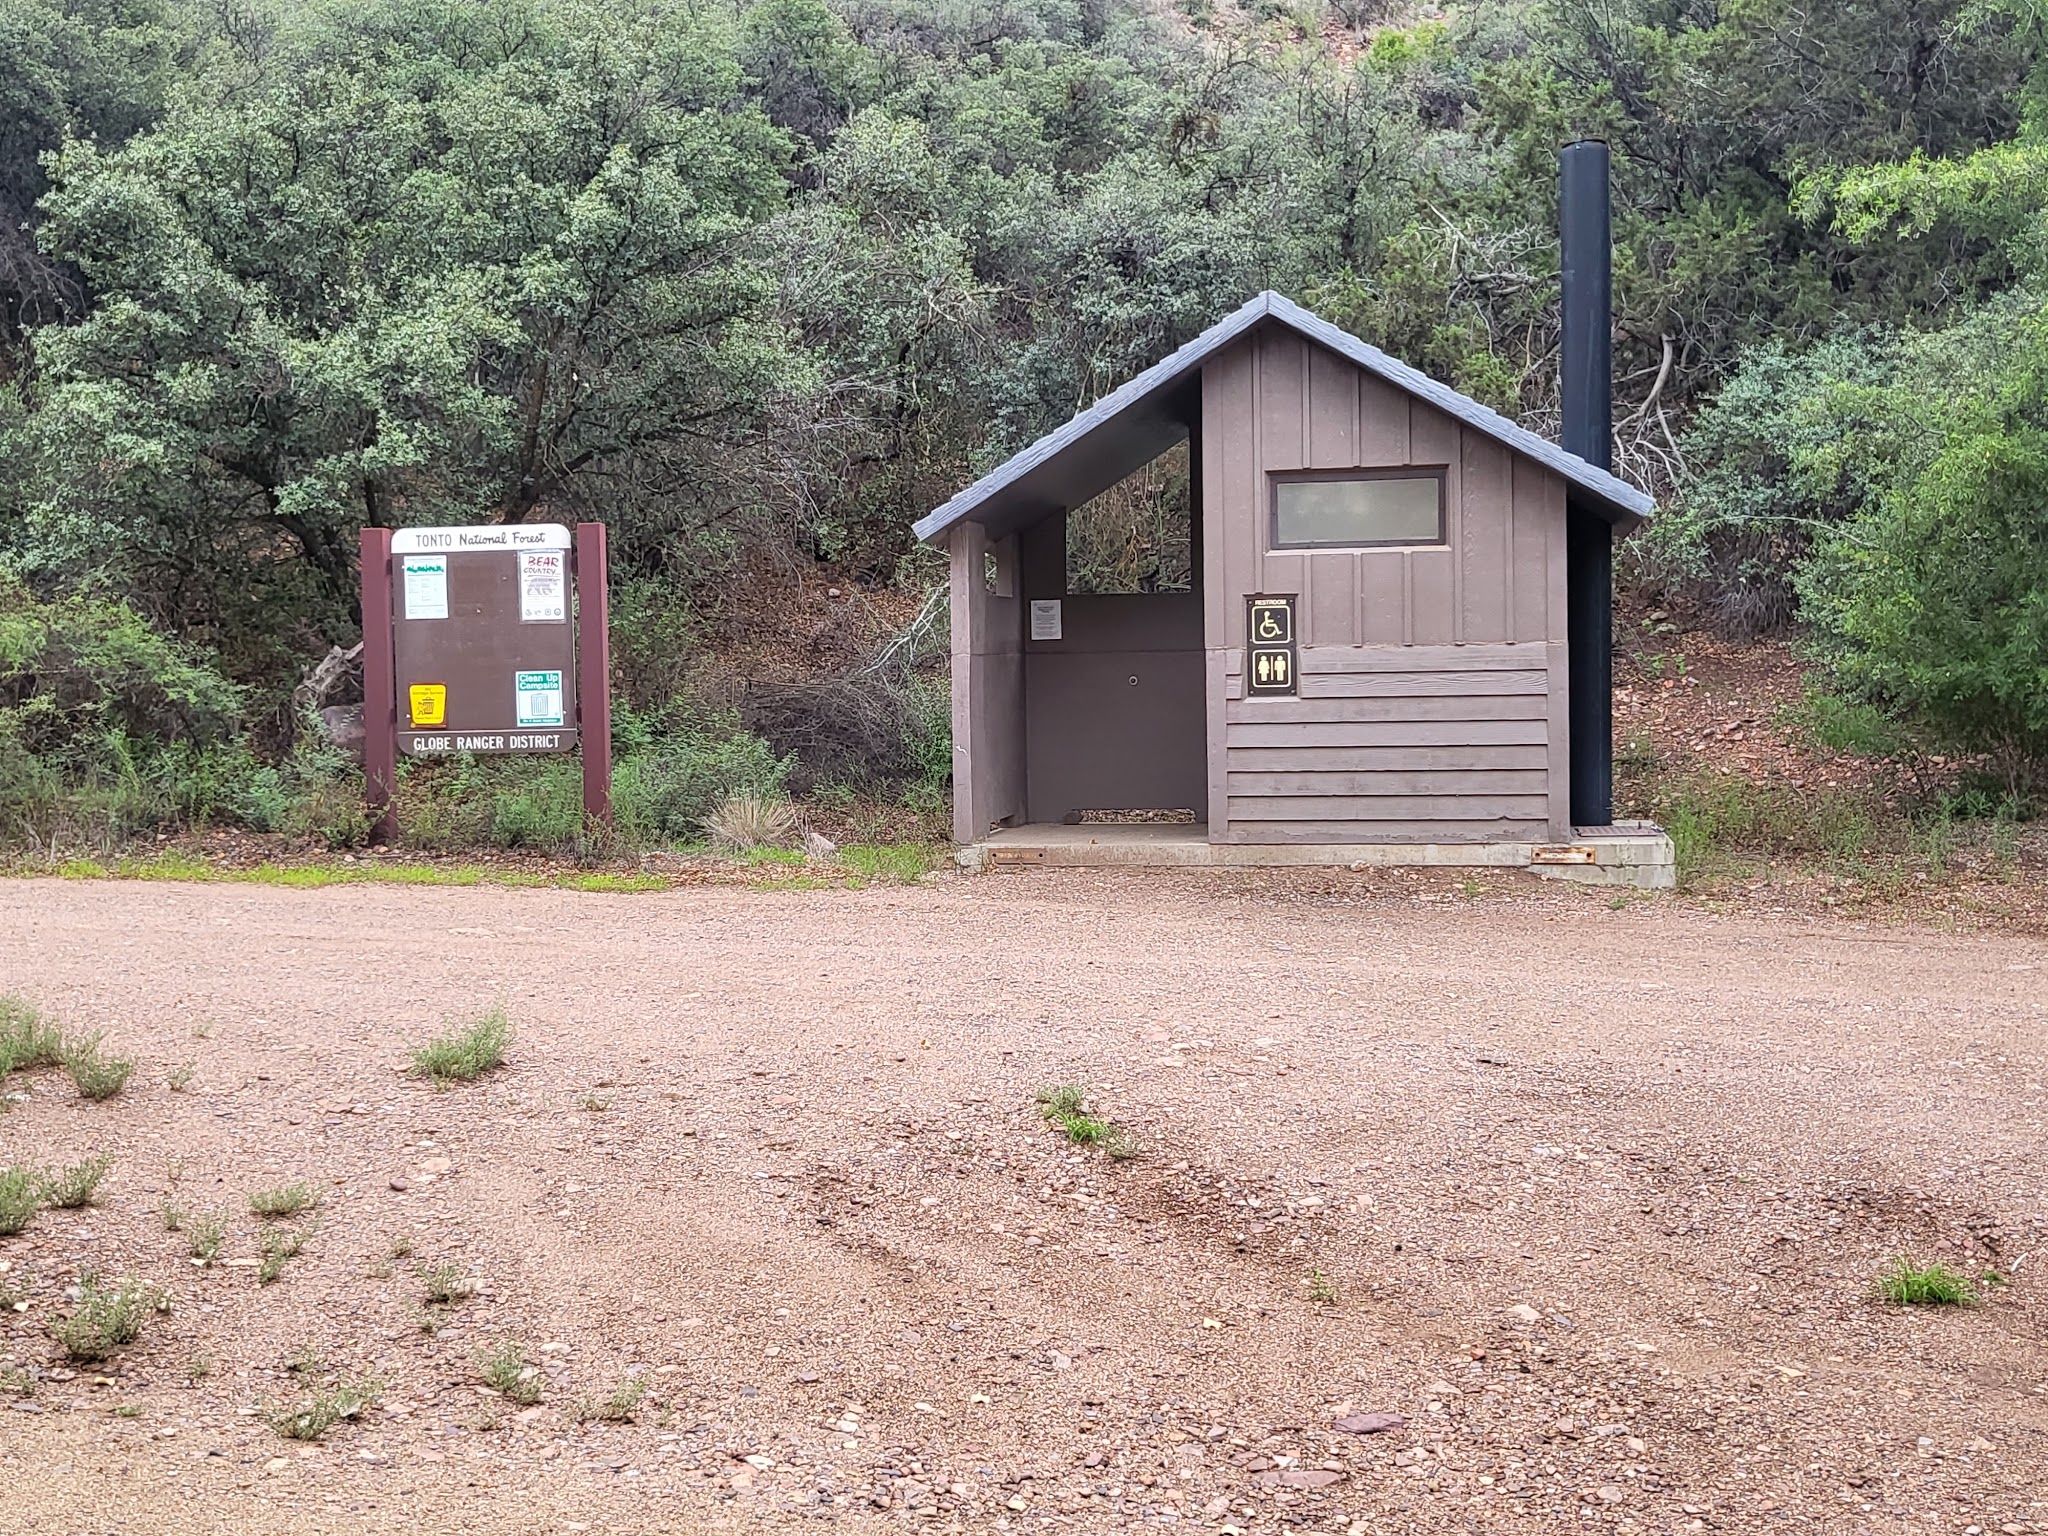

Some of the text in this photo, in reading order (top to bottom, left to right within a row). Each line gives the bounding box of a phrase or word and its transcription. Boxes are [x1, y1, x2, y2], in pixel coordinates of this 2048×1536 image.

[416, 531, 546, 547] TONTO National Forest
[528, 556, 559, 567] BEAR
[519, 673, 558, 683] Clean Up
[519, 682, 559, 690] Campsite
[413, 734, 561, 751] GLOBE RANGER DISTRICT
